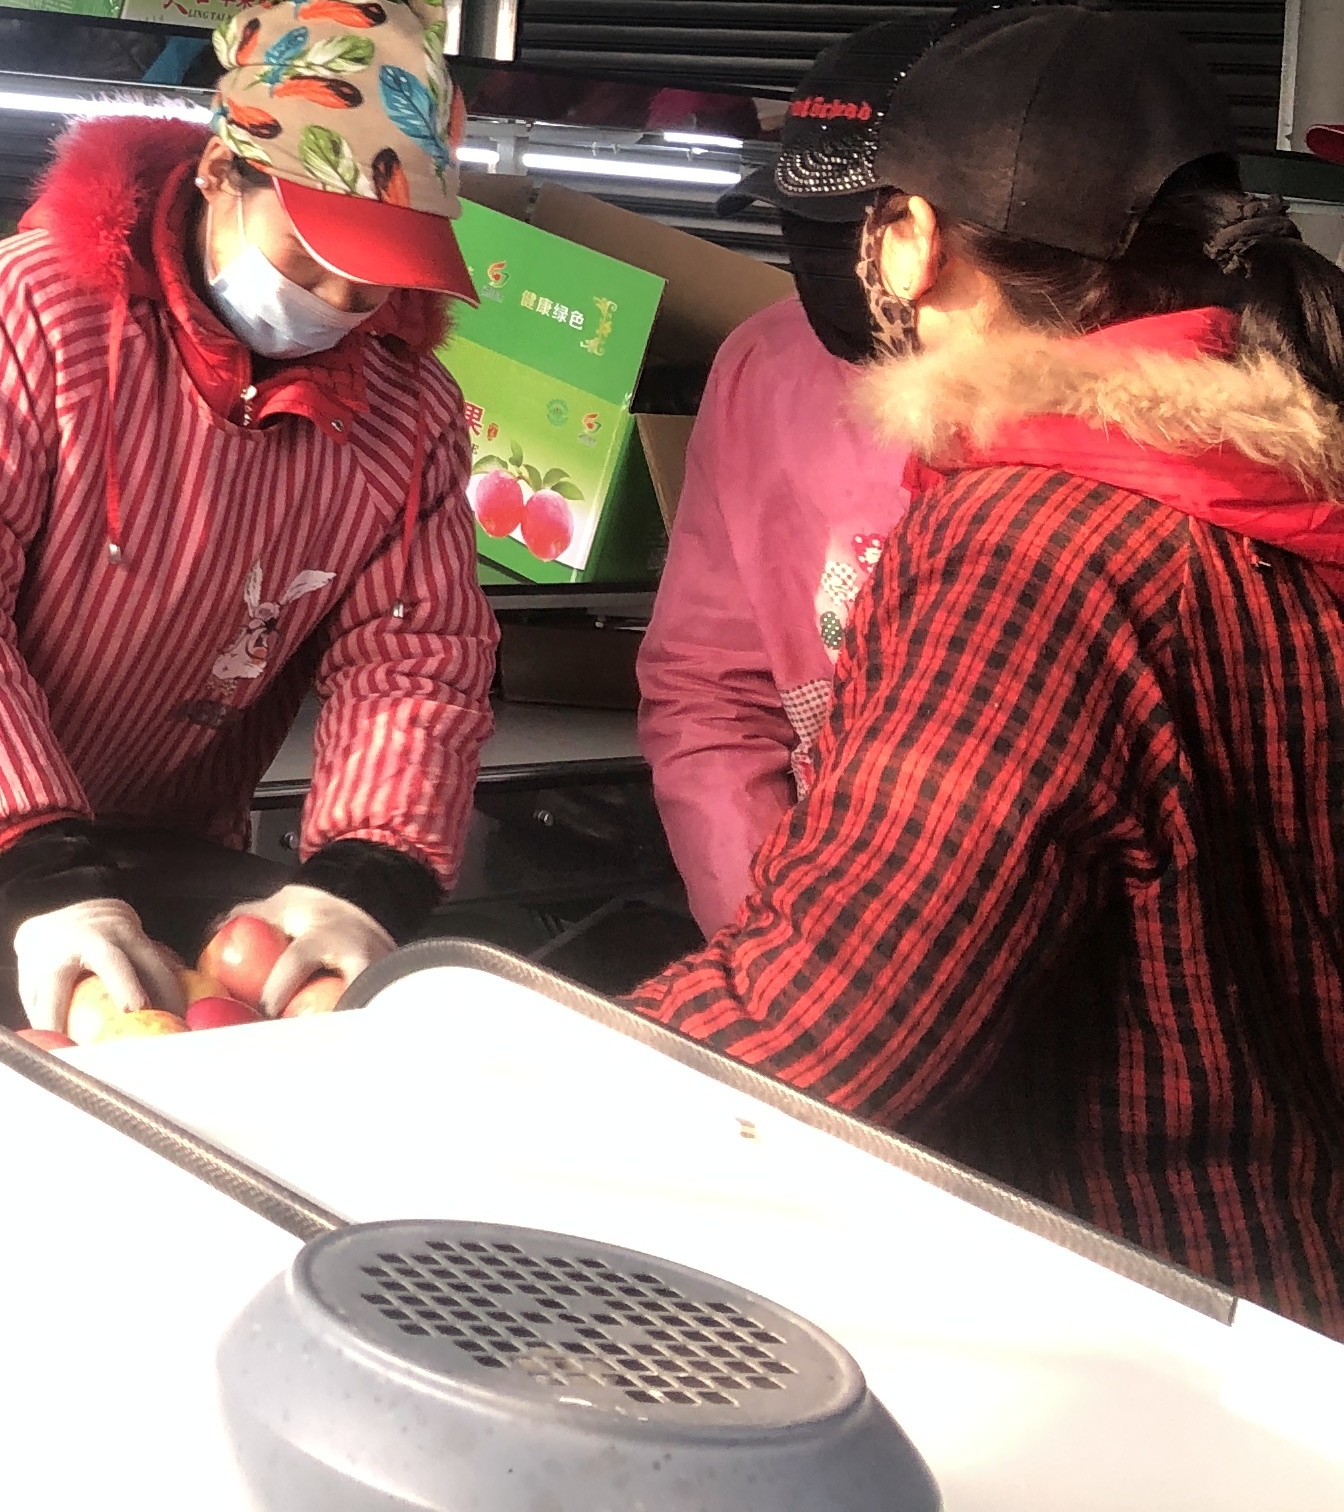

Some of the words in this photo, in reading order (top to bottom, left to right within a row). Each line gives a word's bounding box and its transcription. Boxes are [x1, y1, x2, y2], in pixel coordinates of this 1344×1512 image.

[188, 8, 209, 20] LING
[210, 11, 226, 22] TAI
[520, 289, 585, 331] 健康绿色
